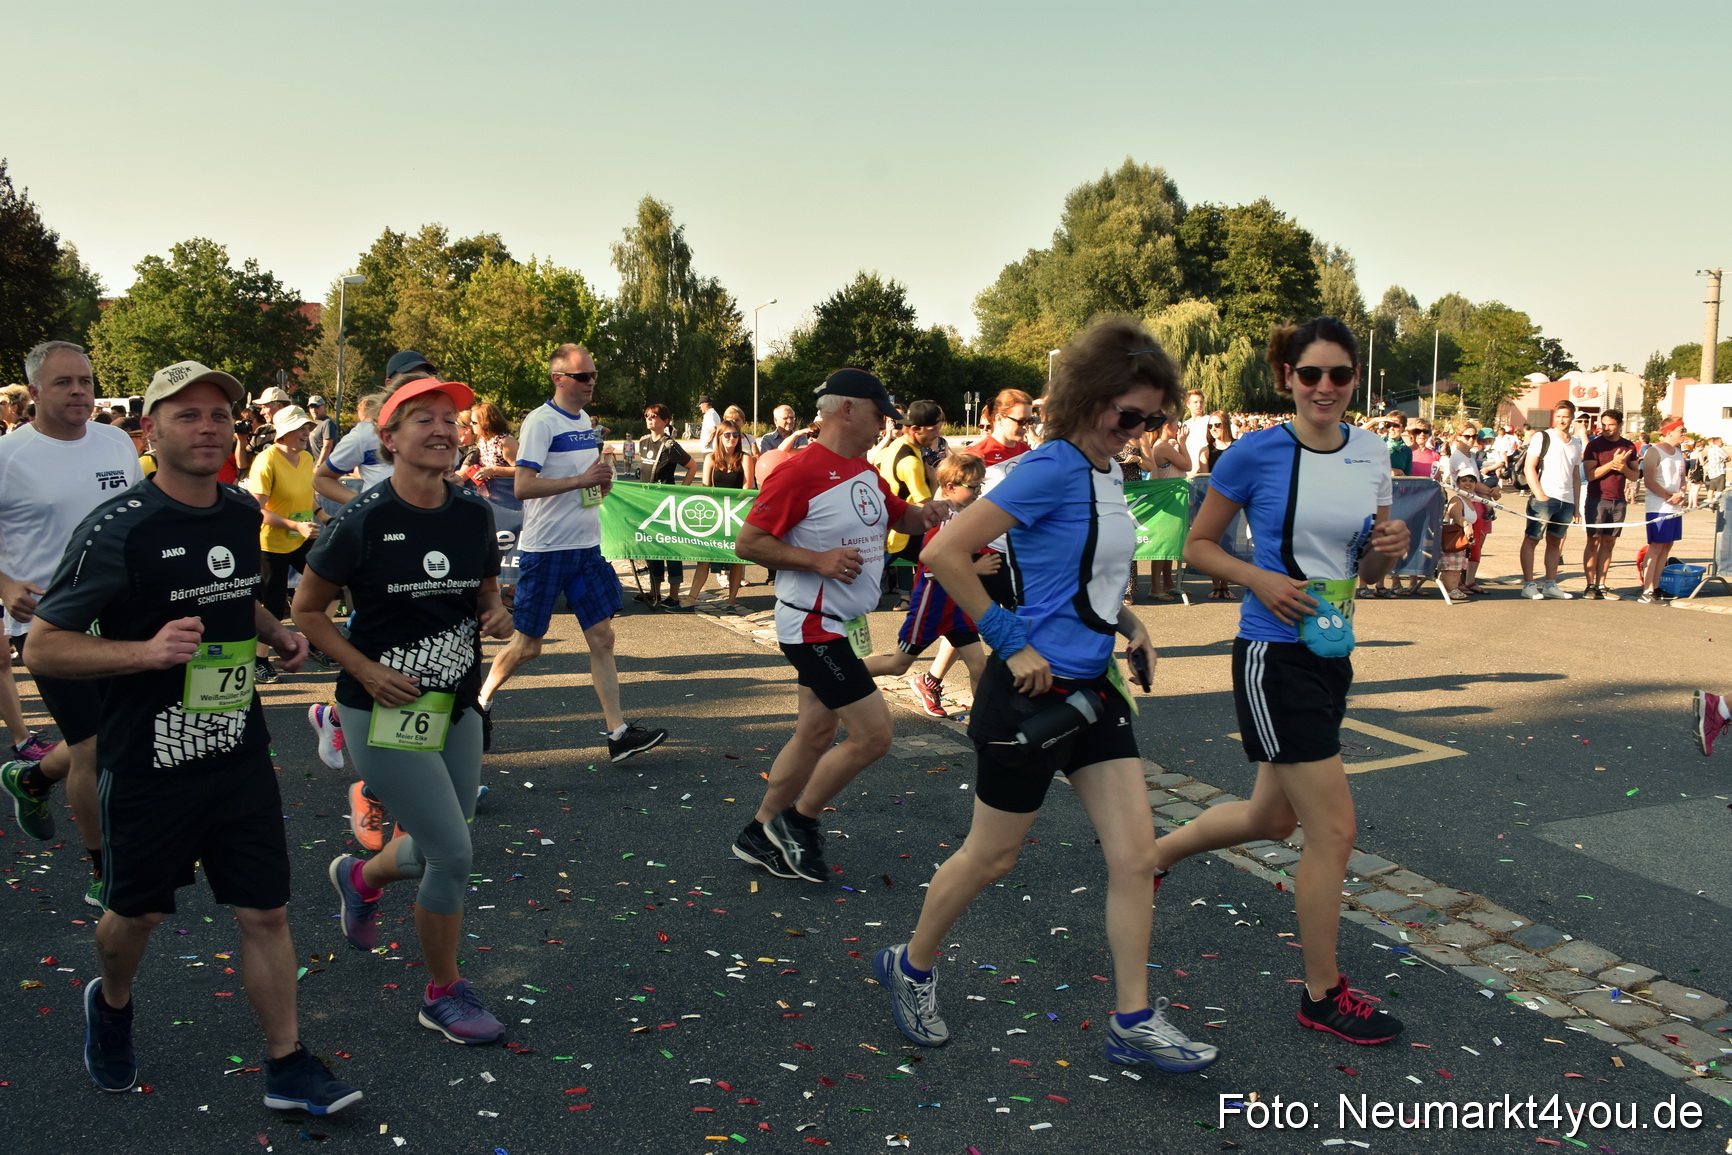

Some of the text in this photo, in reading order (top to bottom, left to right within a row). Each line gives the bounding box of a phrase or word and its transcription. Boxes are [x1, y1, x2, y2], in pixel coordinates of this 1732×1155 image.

[169, 366, 192, 378] ROCK
[579, 432, 595, 441] PLAS
[638, 494, 755, 538] AOK
[383, 533, 406, 542] JAKO
[635, 532, 1153, 550] Die Gesundheitska se.
[841, 535, 870, 547] LAUFEN
[161, 546, 186, 559] JAKO
[197, 587, 252, 606] SCHOTTERWERKE
[410, 588, 464, 599] SCHOTTERWERKE
[218, 666, 247, 692] 79
[200, 693, 239, 701] Weißmüller
[400, 710, 430, 735] 76
[395, 732, 414, 740] Meier
